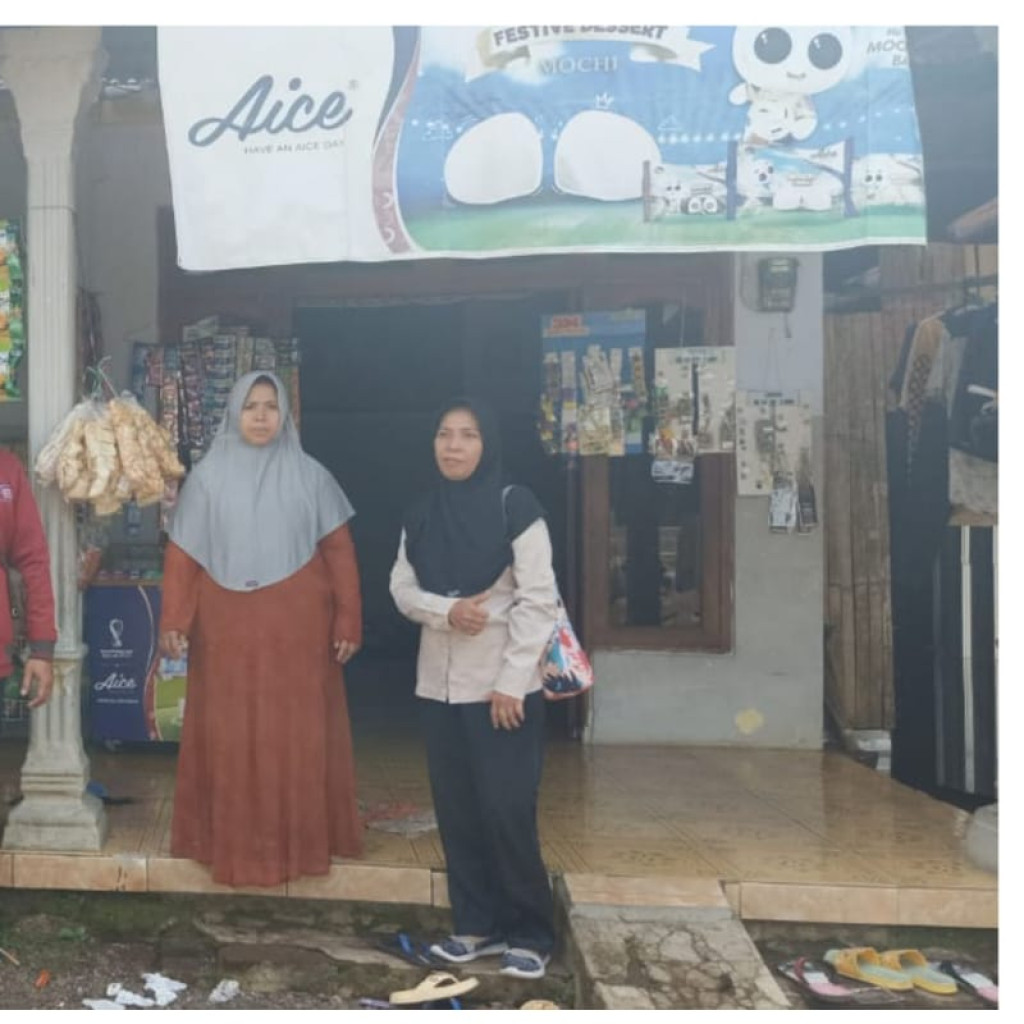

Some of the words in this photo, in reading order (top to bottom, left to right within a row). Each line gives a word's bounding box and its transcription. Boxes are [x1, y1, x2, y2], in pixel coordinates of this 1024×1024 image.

[540, 55, 619, 74] MOCHI
[188, 75, 353, 147] Aice
[244, 144, 274, 154] HAVE
[276, 143, 293, 152] AN
